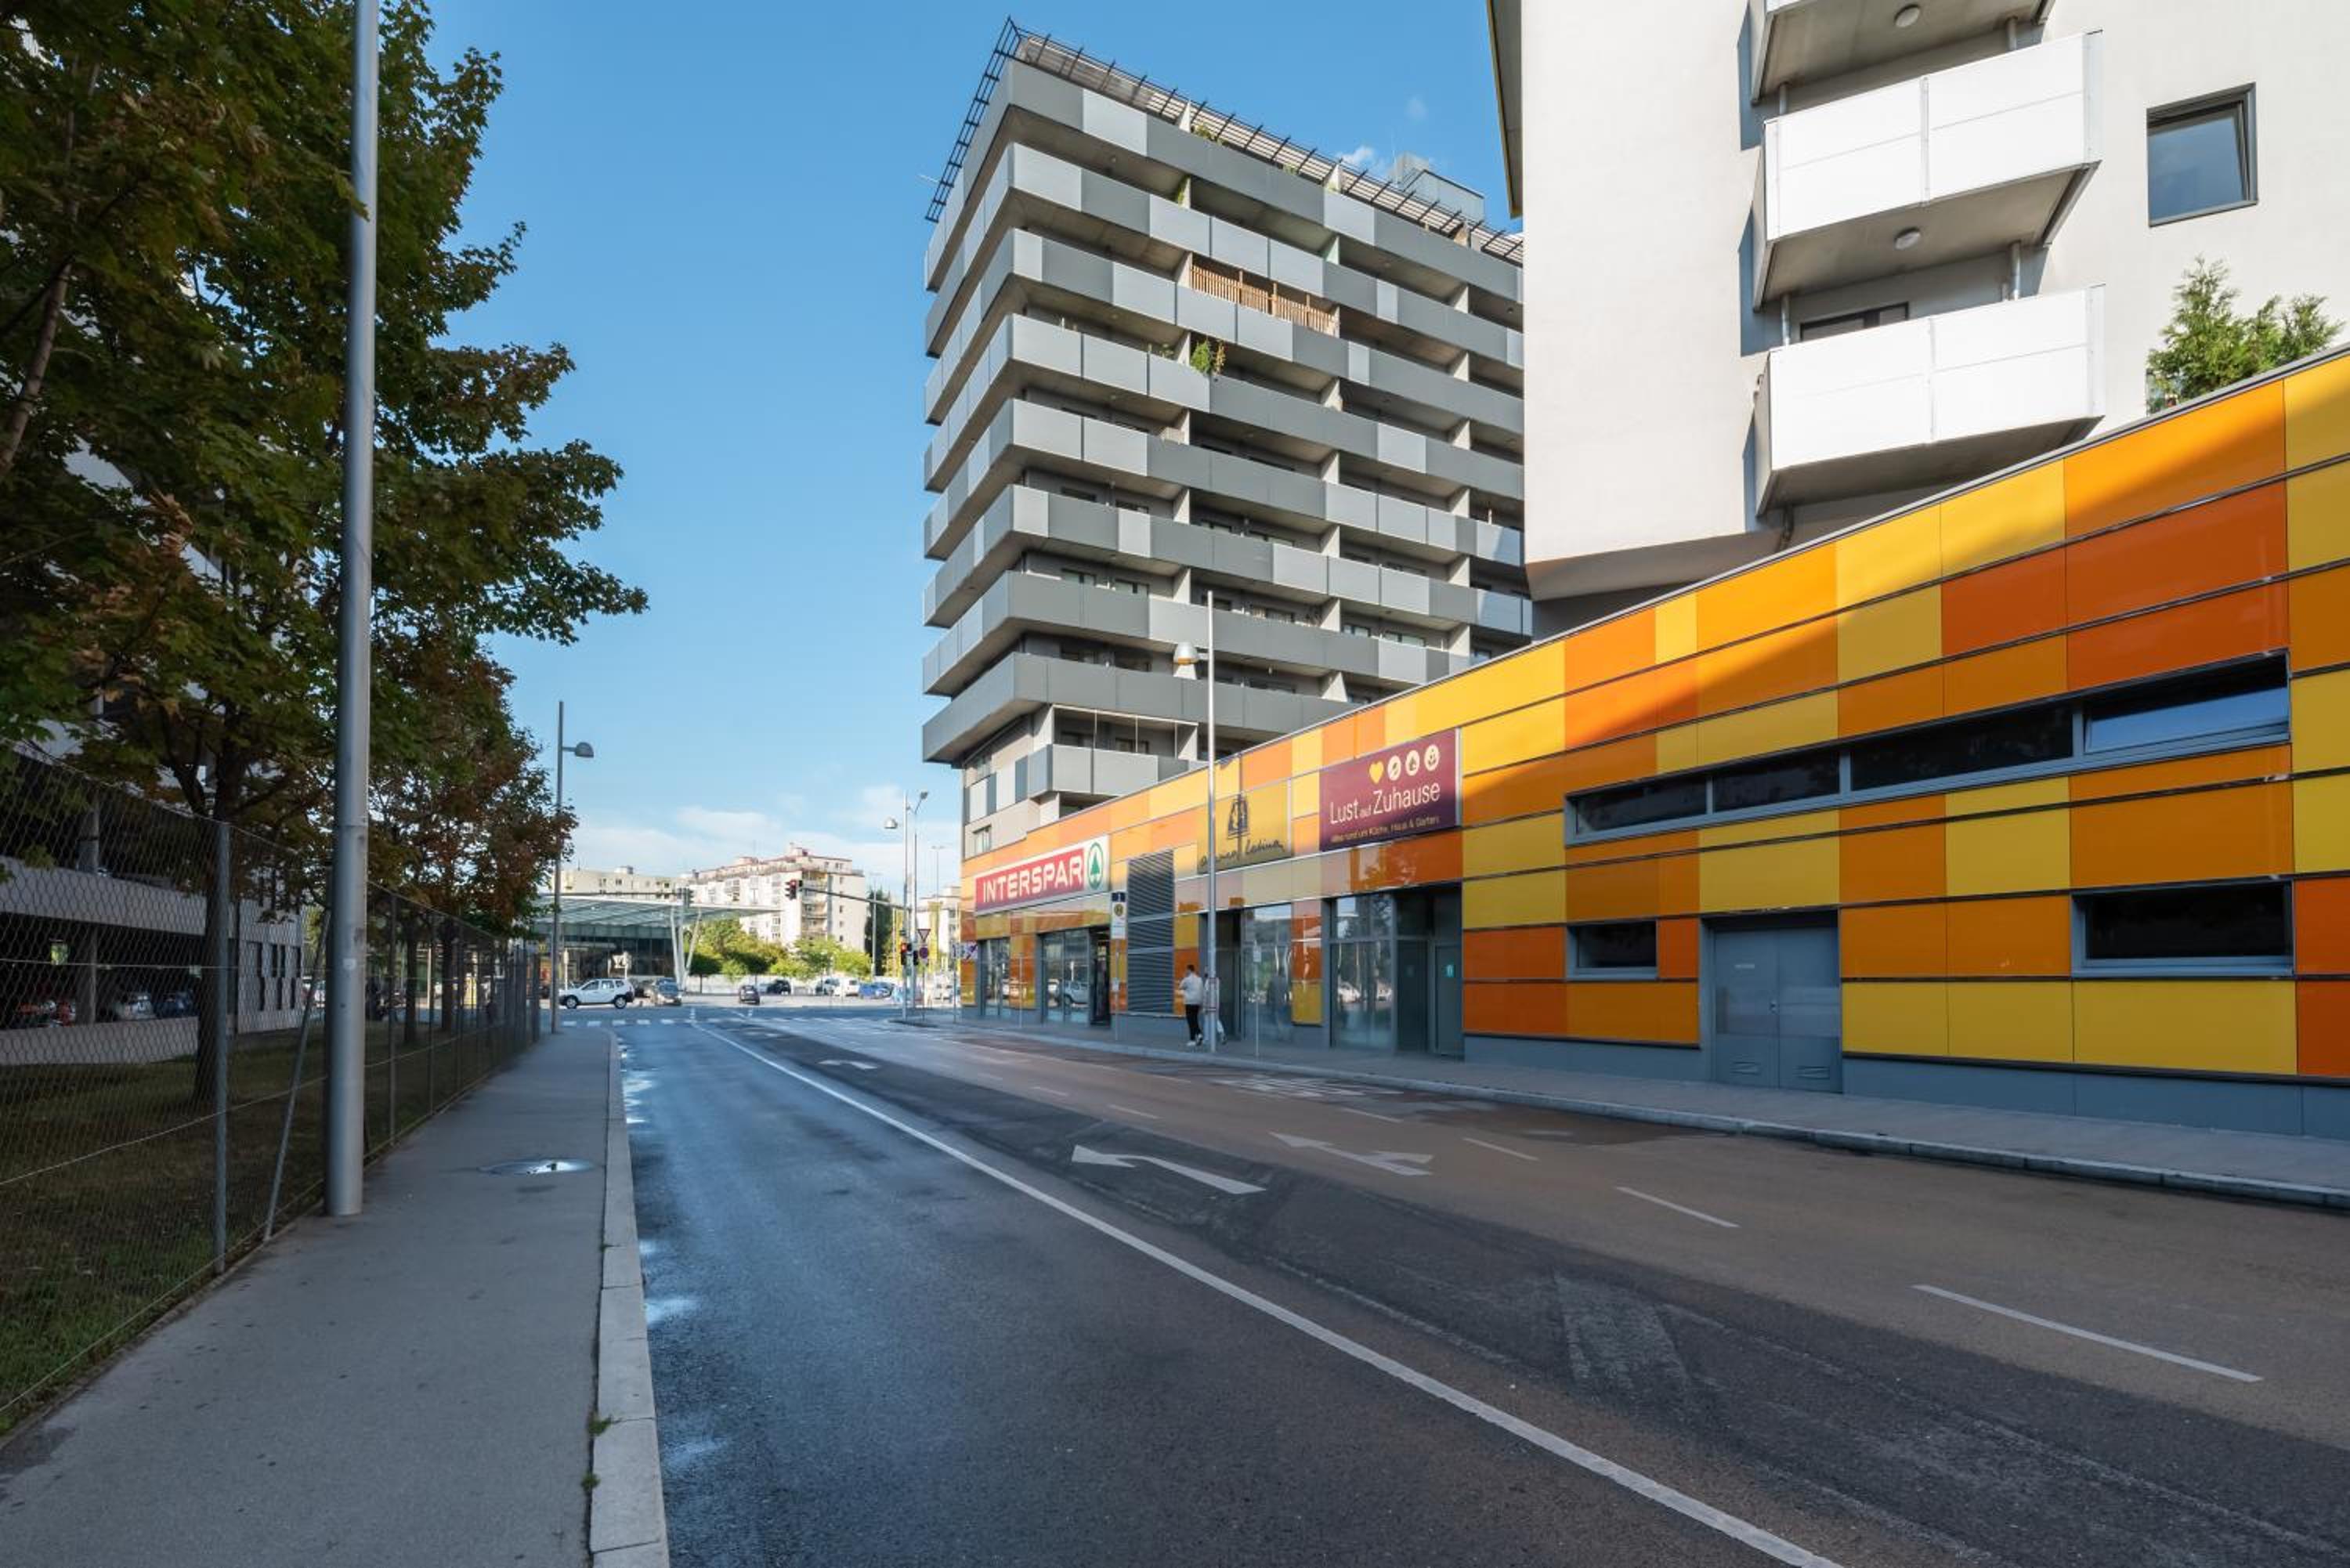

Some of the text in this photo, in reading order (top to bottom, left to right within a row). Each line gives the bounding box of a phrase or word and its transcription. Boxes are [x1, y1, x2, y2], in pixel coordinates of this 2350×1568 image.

[1329, 800, 1358, 825] Lust
[1373, 782, 1441, 815] Zuhause
[982, 855, 1083, 904] INTERSPAR
